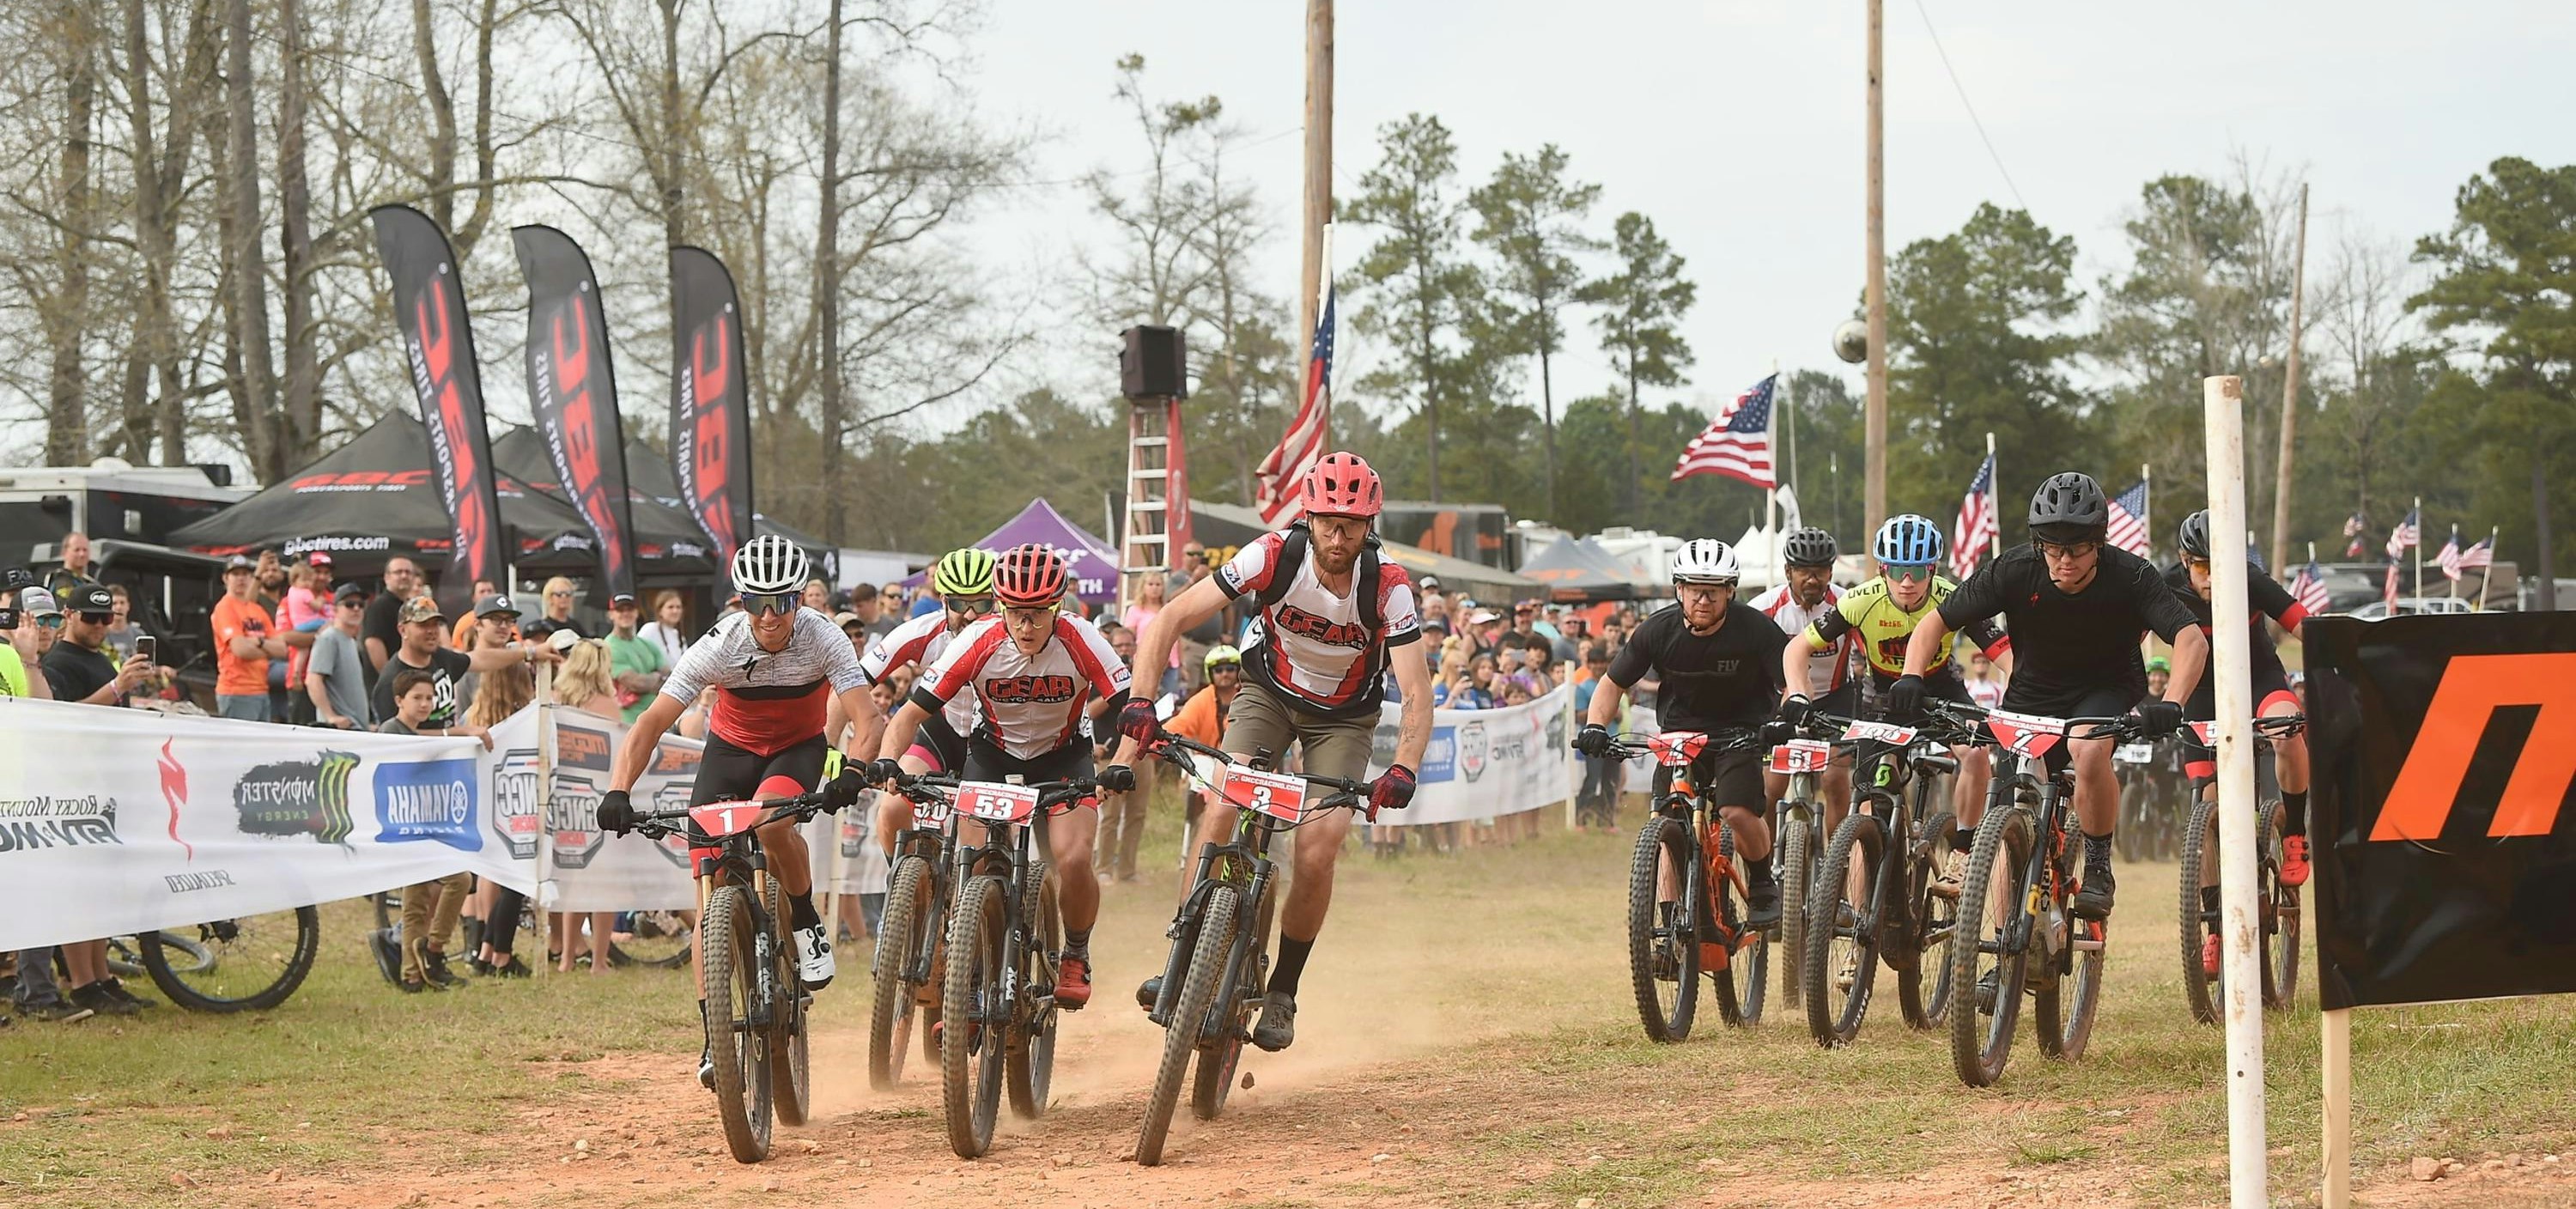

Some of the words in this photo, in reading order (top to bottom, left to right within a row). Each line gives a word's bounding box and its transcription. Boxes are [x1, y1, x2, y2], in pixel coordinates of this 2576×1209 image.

[283, 536, 390, 556] gbctires.com
[1848, 588, 1870, 598] LIVE
[1873, 584, 1882, 594] IT
[1280, 606, 1364, 644] GEAR
[1717, 659, 1740, 672] FLY
[989, 676, 1072, 698] GEAR
[1788, 748, 1812, 769] 51
[974, 794, 1015, 820] 53
[1250, 785, 1273, 811] 3
[719, 809, 734, 834] 1
[1005, 966, 1018, 1000] FOX
